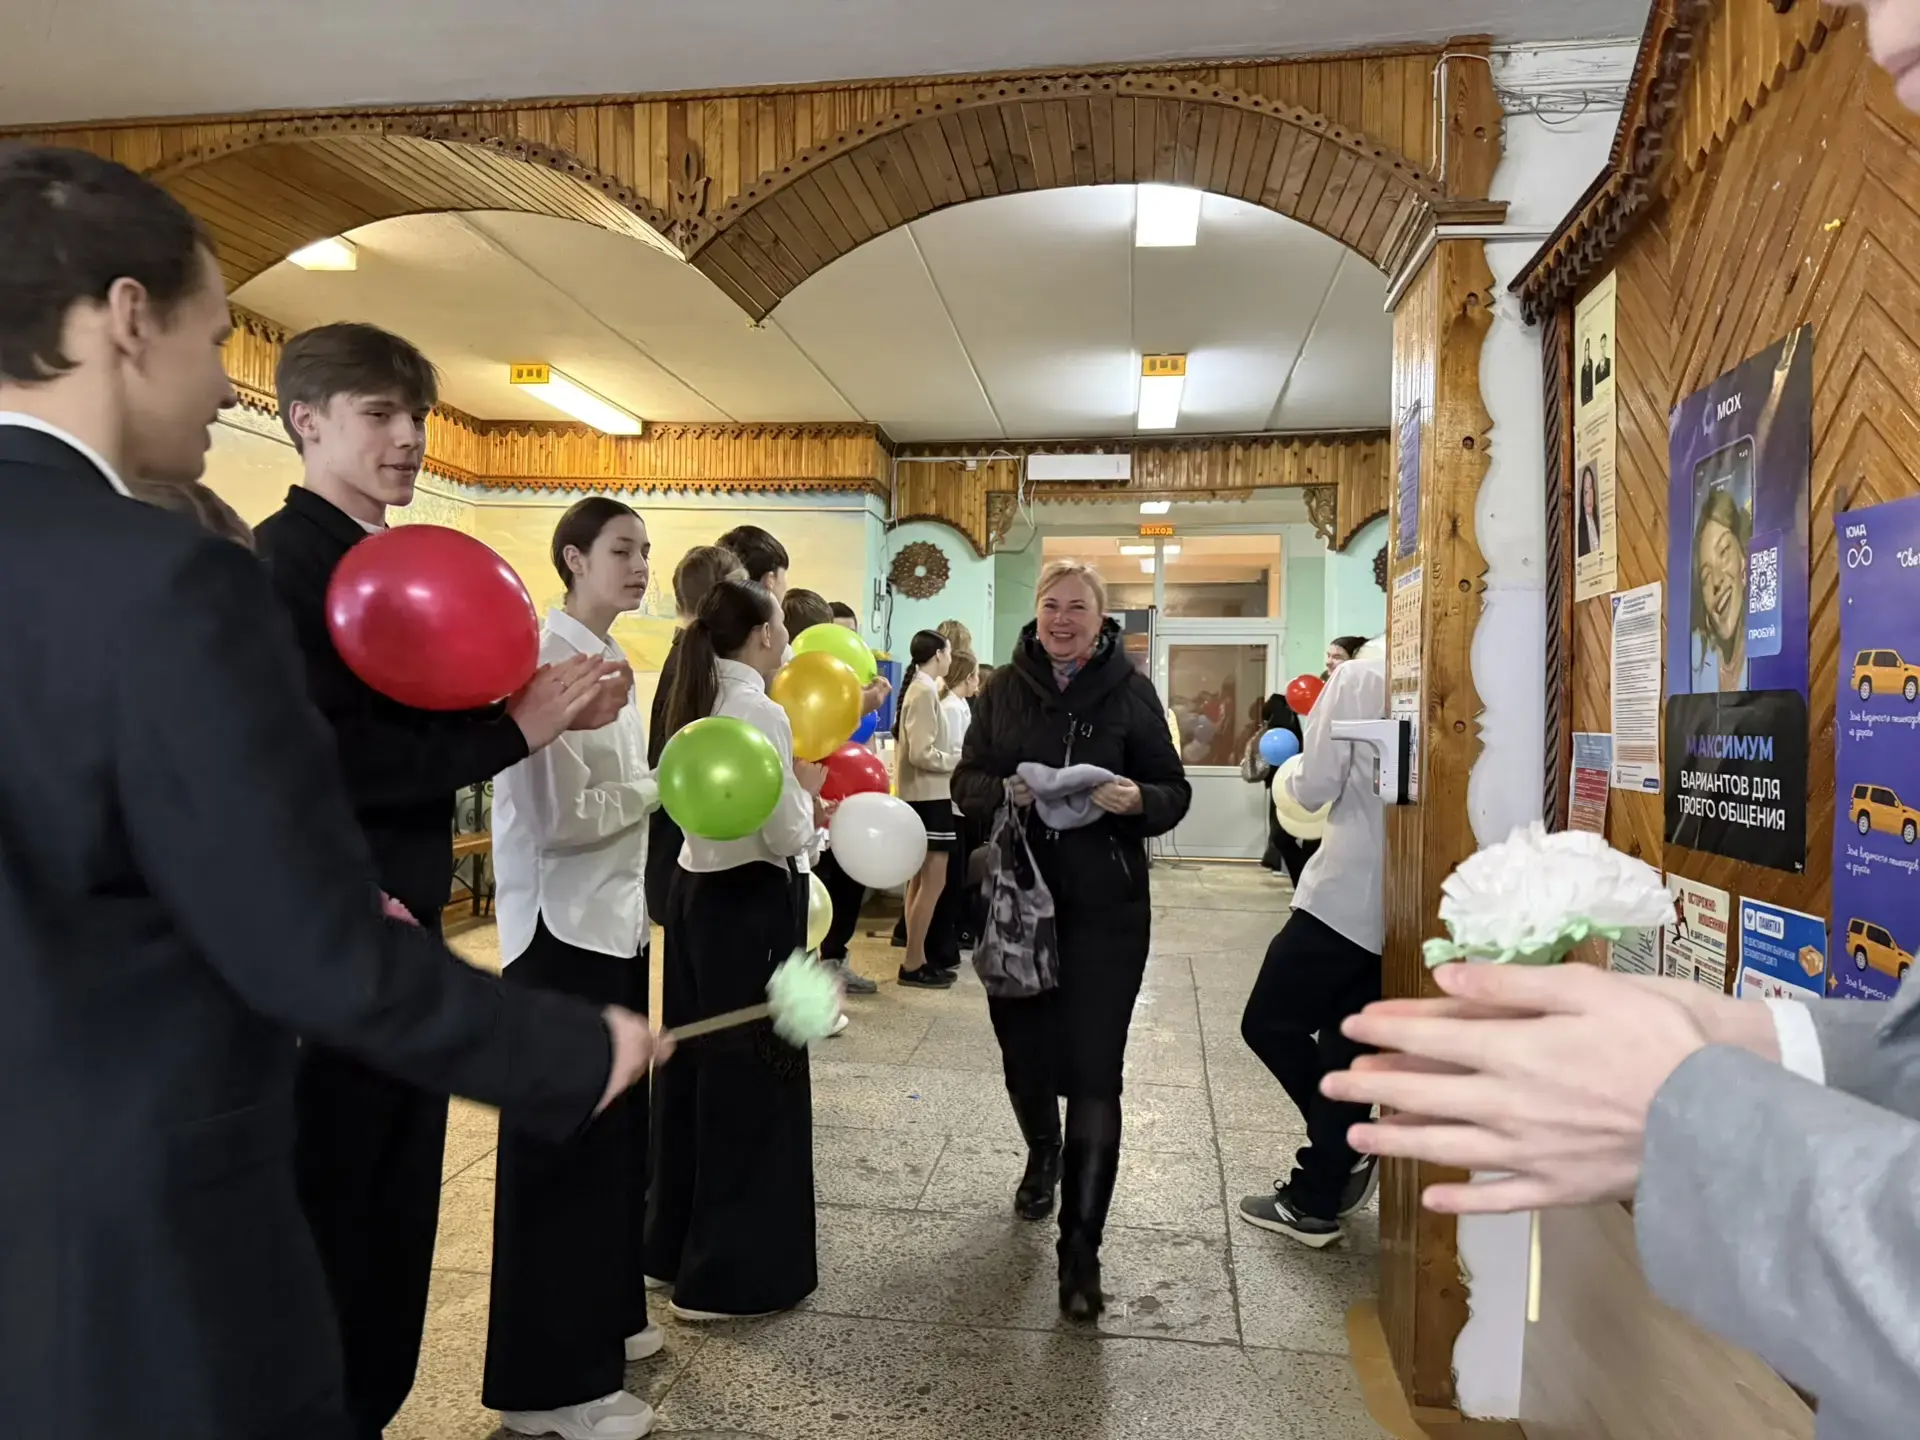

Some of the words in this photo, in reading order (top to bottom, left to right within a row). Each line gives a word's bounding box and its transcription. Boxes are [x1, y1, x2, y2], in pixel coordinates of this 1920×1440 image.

[1140, 527, 1173, 536] ВЫХОД
[1748, 624, 1776, 640] ПРОБУЙ
[1685, 735, 1774, 761] МАКСИМУМ
[1680, 770, 1749, 796] ВАРИАНТОВ
[1752, 777, 1781, 802] ДЛЯ
[1677, 794, 1716, 819] ТВОЕГО
[1718, 801, 1786, 831] ОБЩЕНИЯ
